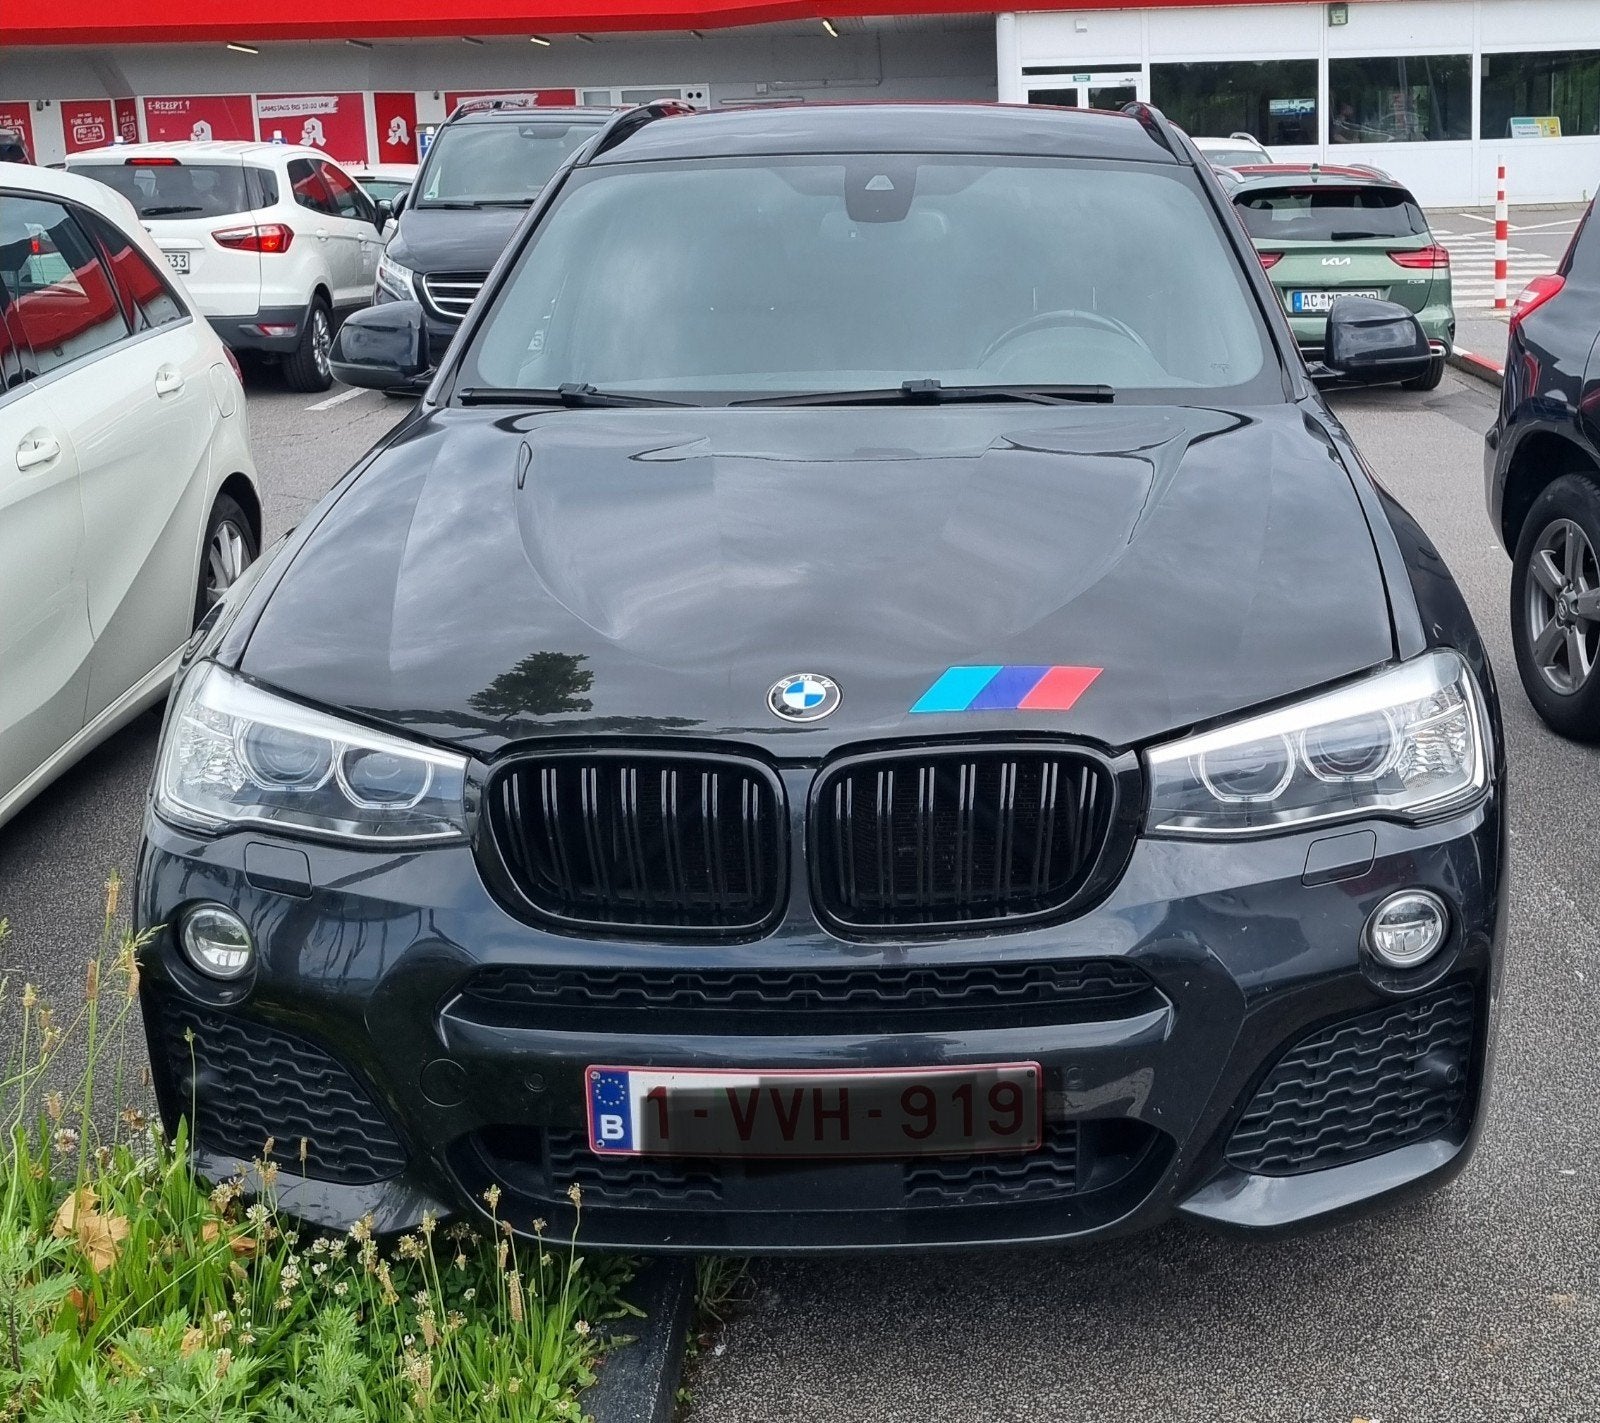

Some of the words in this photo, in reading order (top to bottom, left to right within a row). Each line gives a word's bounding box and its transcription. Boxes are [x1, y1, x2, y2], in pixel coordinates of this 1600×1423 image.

[1321, 257, 1351, 266] KIA
[1303, 292, 1318, 308] AC
[778, 675, 834, 688] BMW
[600, 1114, 625, 1140] B
